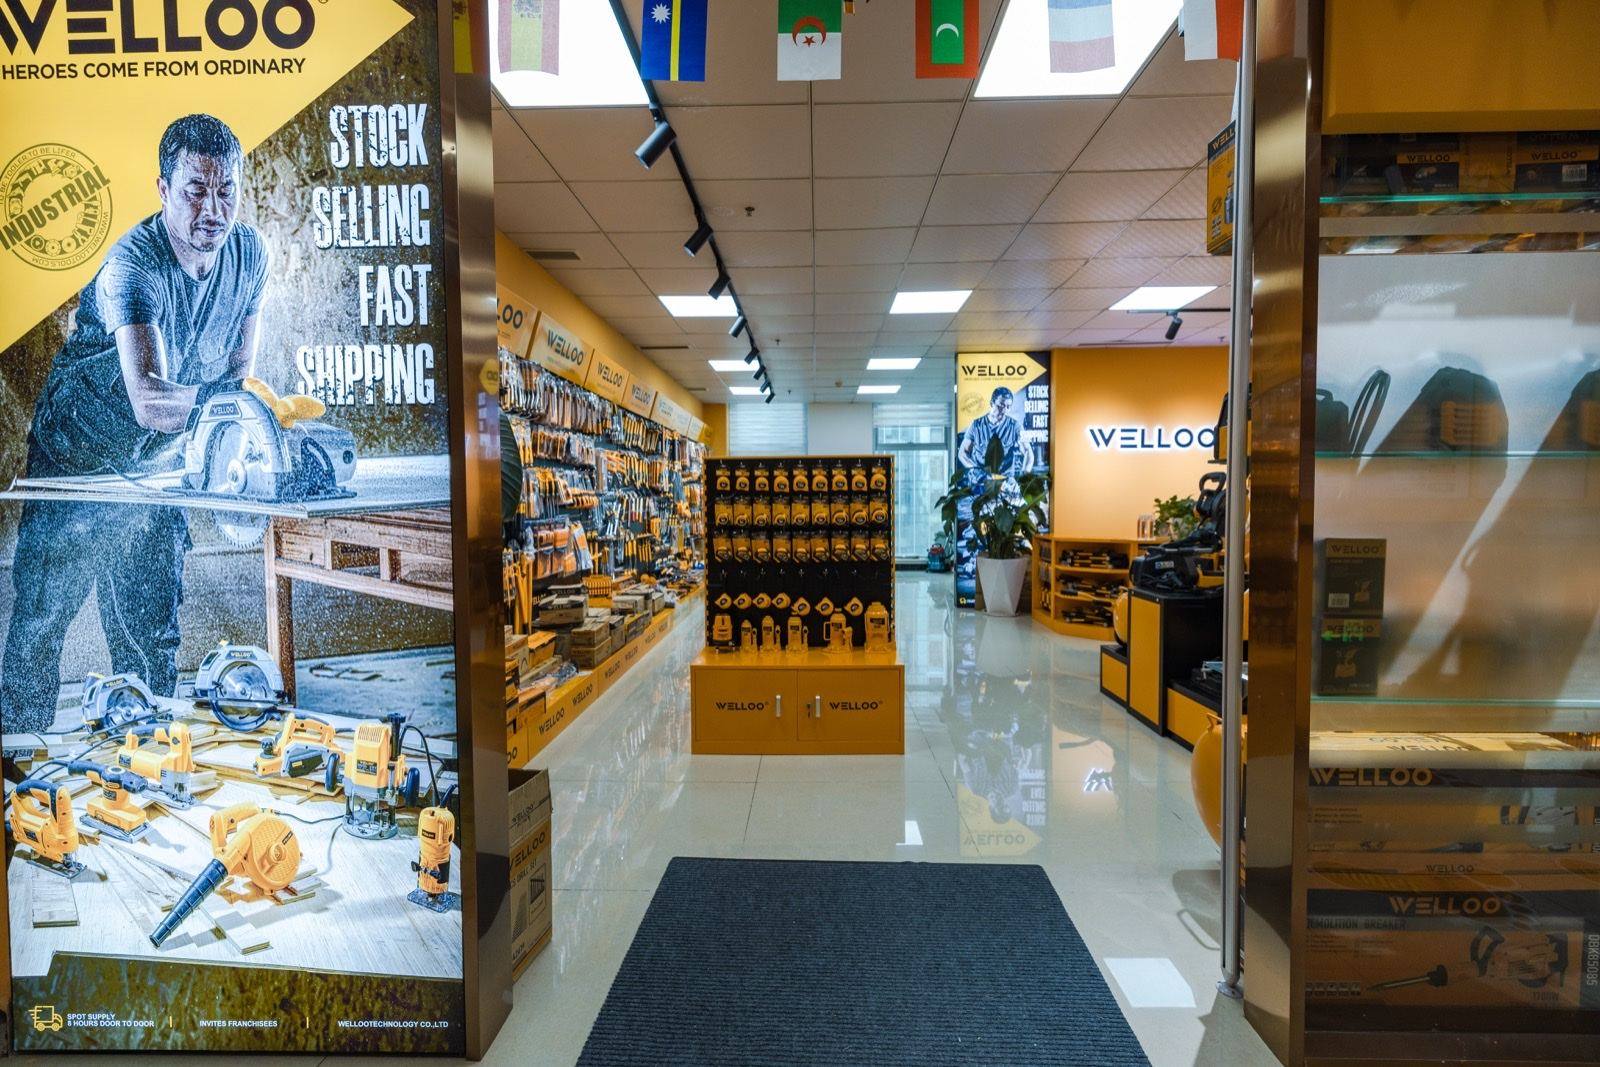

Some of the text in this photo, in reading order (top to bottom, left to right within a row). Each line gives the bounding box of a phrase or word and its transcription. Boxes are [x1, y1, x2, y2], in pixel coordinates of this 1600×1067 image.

[0, 0, 316, 55] WELLOO
[2, 58, 306, 80] HEROES COME FROM ORDINARY
[329, 104, 429, 168] STOCK
[0, 165, 111, 250] INDUSTRIAL
[312, 183, 431, 248] SELLING
[358, 264, 432, 326] FAST
[547, 330, 584, 365] WELLOO
[297, 343, 435, 406] SHIPPING
[962, 365, 1027, 376] WELLOO
[1028, 385, 1049, 398] STOCK
[1024, 400, 1049, 413] SELLING
[1033, 415, 1049, 427] FAST
[1089, 428, 1215, 448] WELLOO
[571, 684, 593, 706] WELLOO
[716, 702, 765, 711] WELLOO
[829, 701, 879, 710] WELLOO
[538, 707, 565, 736] WELLOO
[1310, 768, 1433, 786] WELLOO
[1426, 865, 1474, 873] WELLOO
[1388, 895, 1501, 915] WELLOO
[338, 1020, 419, 1028] WELLOOTECHNOLOGY
